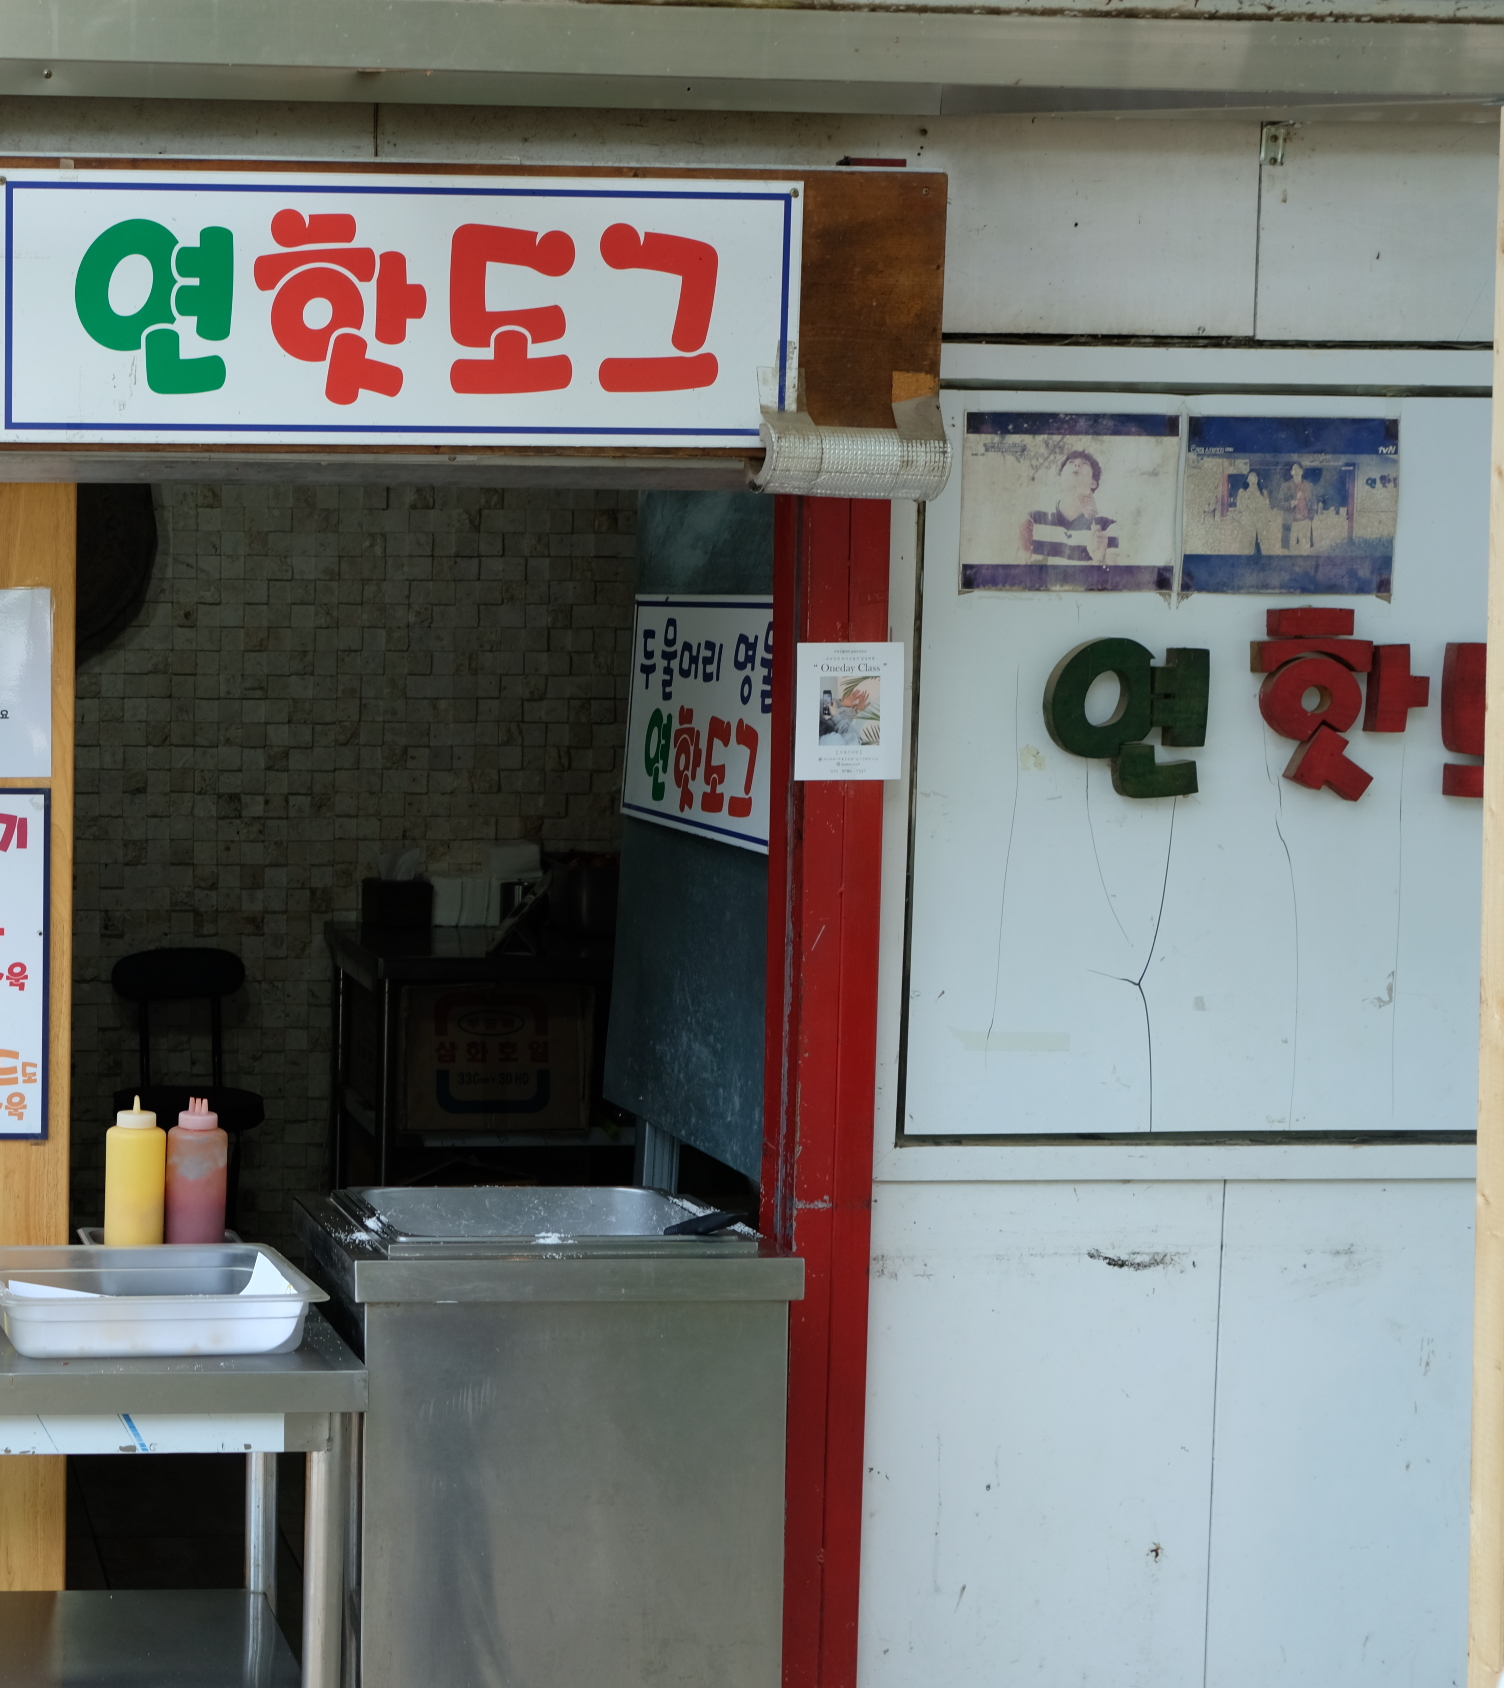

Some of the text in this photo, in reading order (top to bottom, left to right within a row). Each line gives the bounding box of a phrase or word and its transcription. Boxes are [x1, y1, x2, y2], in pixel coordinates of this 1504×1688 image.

[75, 208, 718, 405] 연핫도그
[640, 618, 723, 701] 두물머리
[820, 663, 881, 674] Oneday Class
[645, 704, 759, 818] 연핫도그
[498, 1072, 513, 1085] 30
